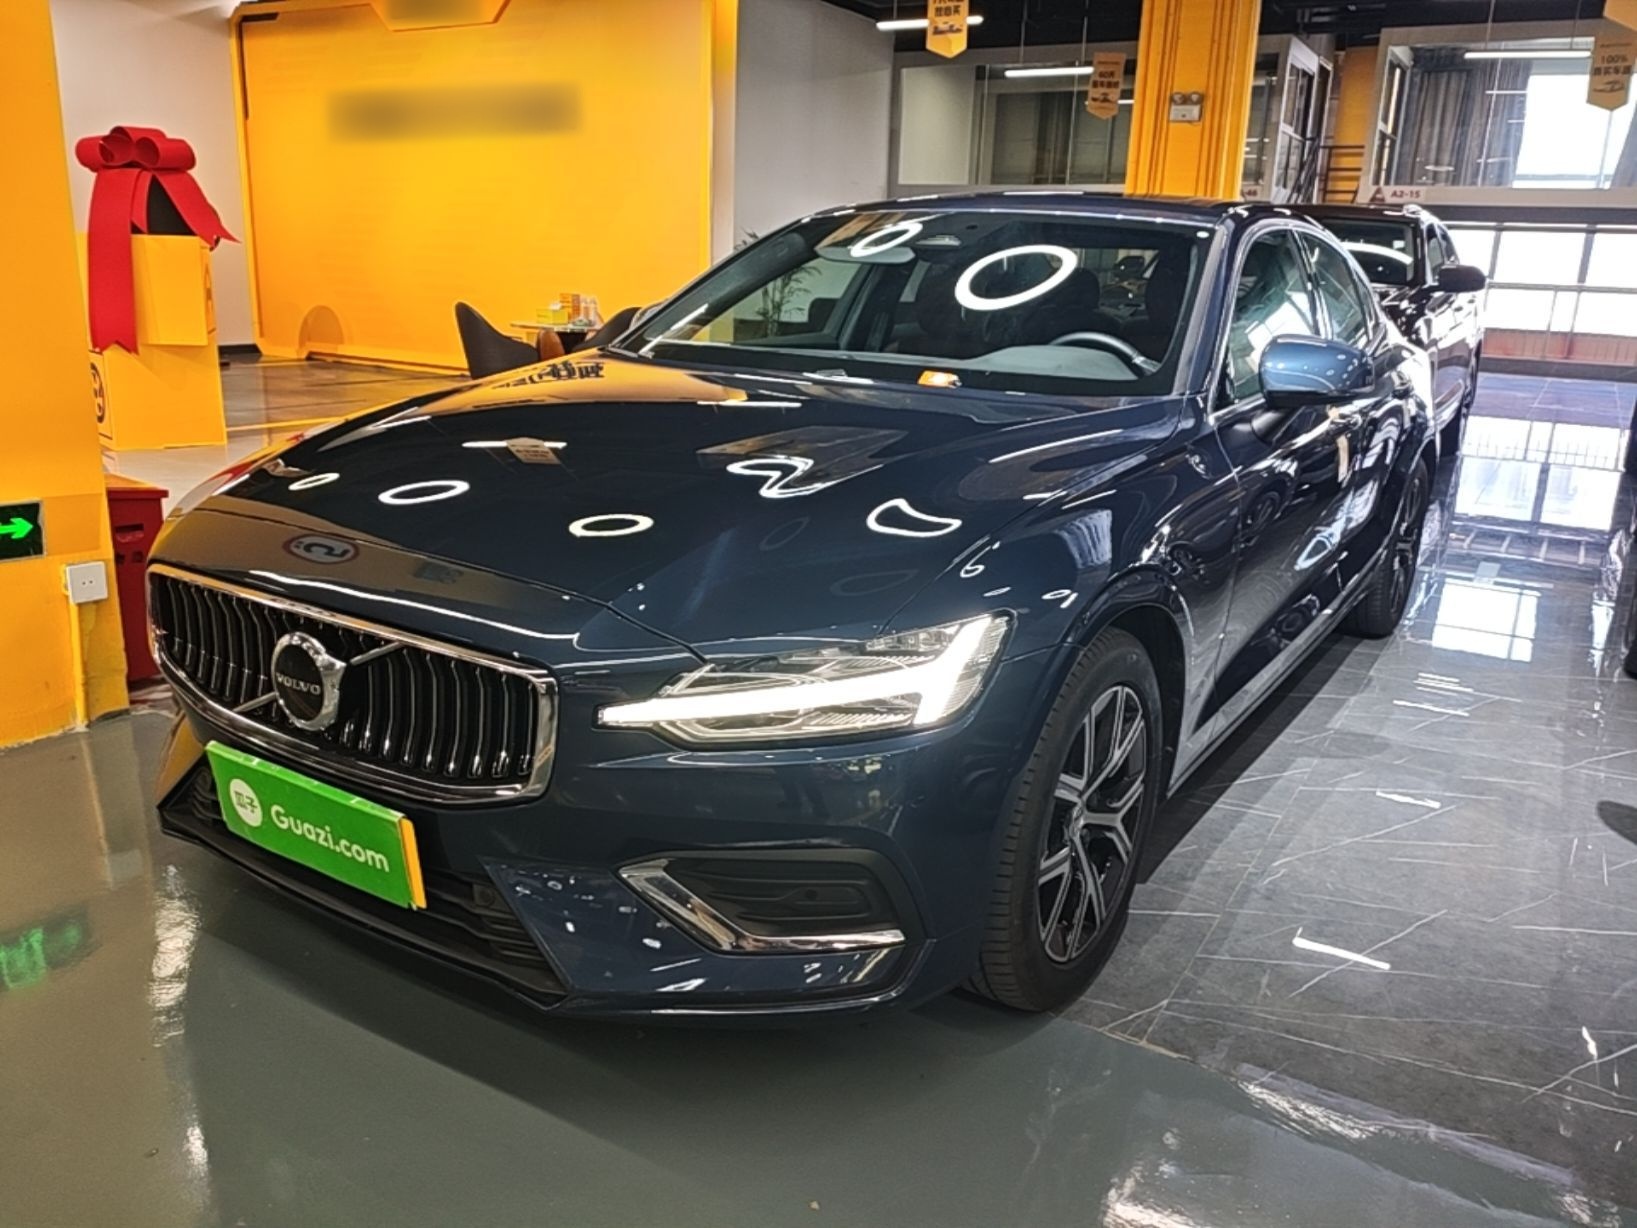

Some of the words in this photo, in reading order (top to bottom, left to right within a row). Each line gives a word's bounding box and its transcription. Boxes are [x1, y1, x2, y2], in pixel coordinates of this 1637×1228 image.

[1390, 189, 1421, 199] A2-15
[275, 672, 322, 695] VOLVO
[270, 804, 390, 873] Guazi.com
